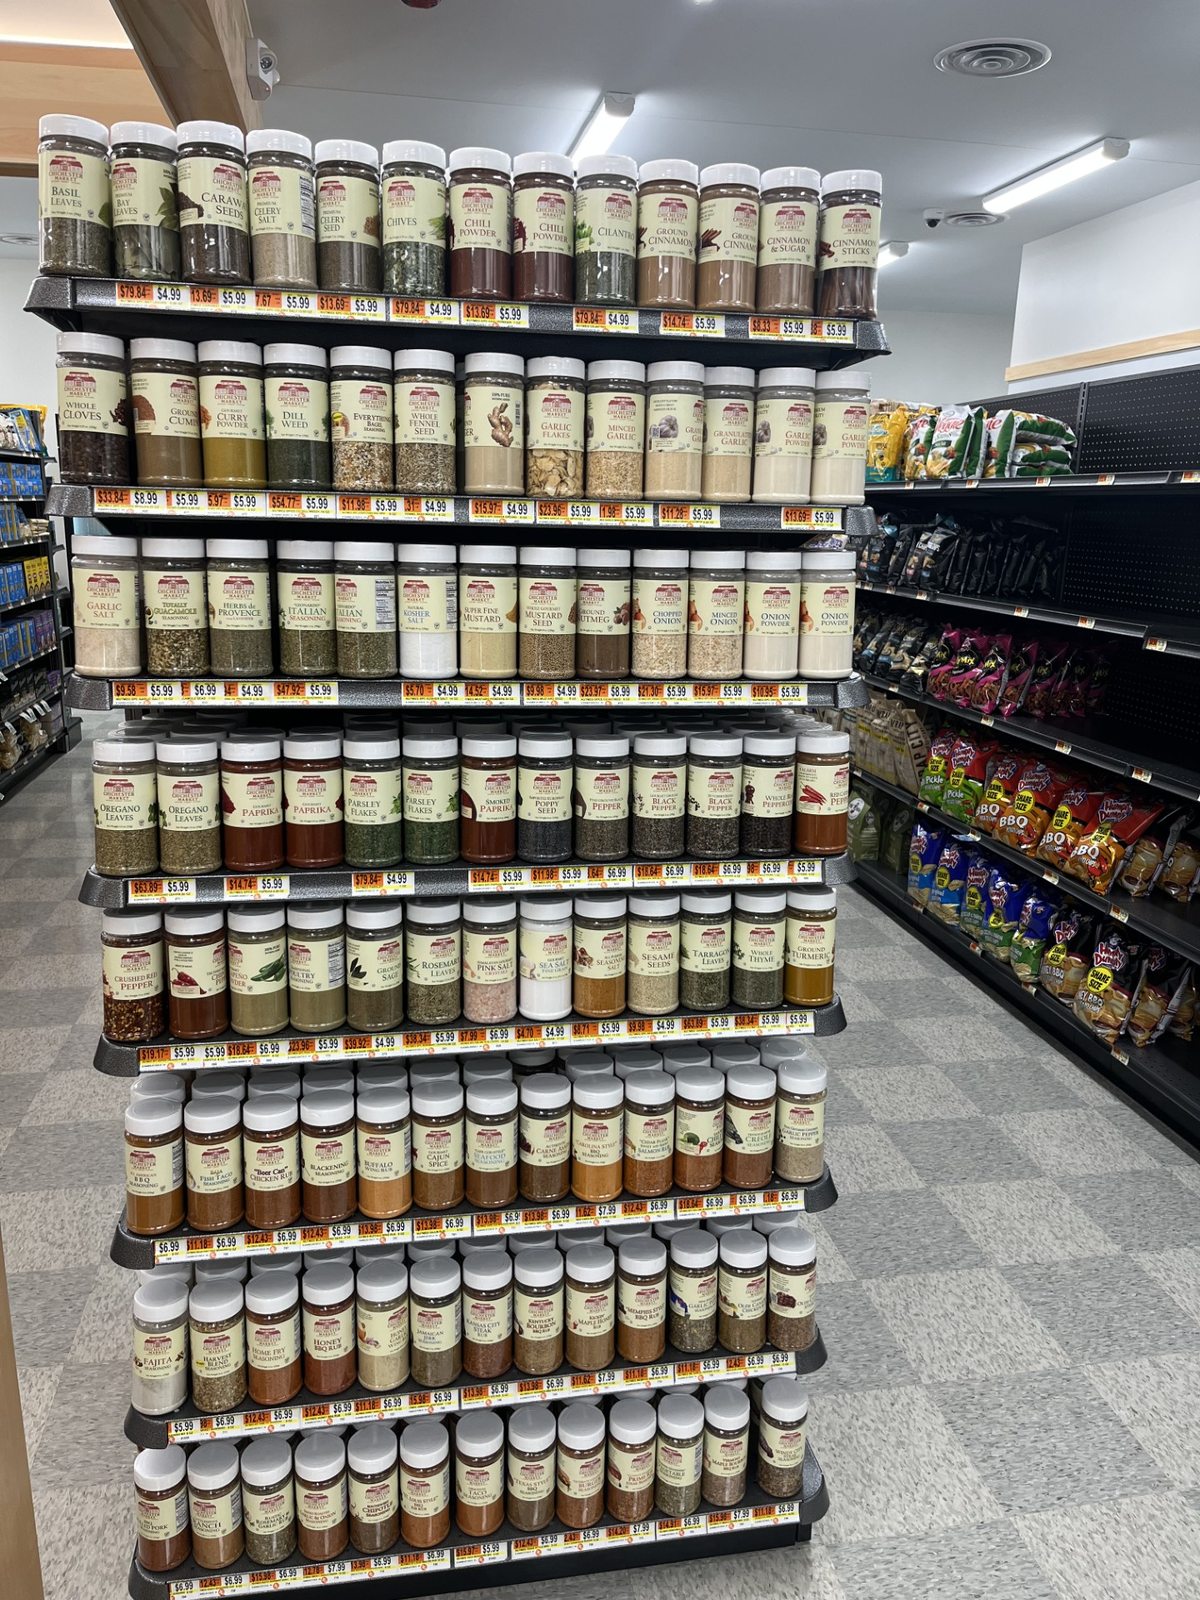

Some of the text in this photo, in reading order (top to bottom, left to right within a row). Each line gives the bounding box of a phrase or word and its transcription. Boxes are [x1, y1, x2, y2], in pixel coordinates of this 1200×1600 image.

[51, 186, 81, 198] BASIL
[51, 197, 82, 208] LEAVES
[259, 215, 276, 223] SALT
[387, 217, 417, 226] CHIVES
[465, 219, 491, 227] CHILI
[460, 228, 497, 237] POWDER
[539, 223, 565, 233] CHILI
[656, 228, 688, 236] GROUND
[780, 245, 806, 253] SUGAR
[842, 247, 870, 255] STICKS
[120, 286, 146, 297] $79.84
[158, 288, 181, 299] $4.99
[287, 296, 310, 308] $5.99
[430, 303, 452, 315] $4.99
[608, 314, 629, 325] $4.99
[783, 322, 803, 333] $5.99
[66, 402, 96, 410] WHOLE
[63, 410, 101, 420] CLOVES
[217, 413, 248, 421] CURRY
[283, 411, 306, 420] DILL
[216, 420, 248, 428] POWDER
[281, 420, 308, 429] WEED
[541, 423, 571, 431] GARLIC
[414, 427, 435, 435] SEED
[607, 432, 636, 440] GARLIC
[135, 493, 157, 504] $8.99
[234, 496, 256, 507] $5.99
[375, 501, 397, 511] $5.99
[507, 504, 528, 515] $4.99
[571, 506, 591, 516] $5.99
[692, 509, 712, 519] $5.99
[87, 602, 122, 610] GARLIC
[93, 610, 115, 618] SALT
[218, 609, 262, 617] PROVENCE
[525, 611, 562, 619] MUSTARD
[821, 612, 848, 620] ONION
[464, 614, 501, 623] MUSTARD
[116, 685, 136, 696] $9.58
[151, 685, 172, 696] $5.99
[241, 686, 263, 696] $4.99
[405, 685, 424, 695] $5.70
[437, 685, 458, 696] $4.99
[557, 685, 577, 696] $4.99
[667, 686, 686, 696] $5.99
[781, 687, 800, 697] $5.99
[925, 776, 944, 784] Pickle
[1015, 792, 1033, 803] SHARE
[100, 804, 140, 813] OREGANO
[535, 800, 560, 808] POPPY
[592, 802, 622, 810] PEPPER
[1015, 801, 1028, 812] SIZE
[168, 805, 209, 814] OREGANO
[294, 806, 331, 814] PAPRIKA
[105, 813, 134, 821] LEAVES
[175, 814, 203, 822] LEAVES
[1000, 815, 1028, 829] BBQ
[723, 864, 741, 874] $6.99
[797, 862, 815, 872] $5.99
[503, 871, 522, 881] $5.99
[608, 868, 626, 877] $6.99
[262, 878, 283, 888] $5.99
[642, 953, 675, 961] SESAME
[498, 962, 513, 970] SALT
[647, 960, 671, 968] SEEDS
[115, 974, 144, 982] CRUSHED
[1090, 970, 1110, 983] SHARE
[120, 981, 153, 990] PEPPER
[1088, 980, 1102, 990] SIZE
[710, 1017, 728, 1027] $5.99
[790, 1013, 807, 1023] $5.99
[602, 1022, 620, 1032] $5.99
[489, 1030, 508, 1039] $6.99
[318, 1039, 339, 1049] $5.99
[375, 1037, 394, 1047] $4.99
[205, 1047, 225, 1057] $5.99
[310, 1162, 348, 1171] BLACKENING
[250, 1174, 277, 1182] CHICKEN
[781, 1191, 798, 1201] $6.99
[705, 1197, 723, 1207] $6.99
[599, 1205, 616, 1215] $7.99
[445, 1218, 464, 1229] $6.99
[332, 1226, 351, 1236] $6.99
[216, 1237, 236, 1248] $6.99
[314, 1338, 342, 1346] HONEY
[204, 1353, 232, 1361] HARVEST
[748, 1356, 764, 1366] $6.99
[772, 1353, 789, 1364] $6.99
[651, 1367, 668, 1377] $6.99
[546, 1379, 564, 1389] $6.99
[434, 1393, 452, 1402] $6.99
[333, 1404, 352, 1414] $6.99
[215, 1417, 234, 1427] $6.99
[778, 1504, 794, 1514] $6.99
[683, 1518, 700, 1528] $6.99
[583, 1530, 600, 1540] $6.99
[541, 1536, 557, 1546] $6.99
[427, 1550, 445, 1561] $6.99
[327, 1563, 345, 1573] $7.99
[224, 1576, 243, 1586] $6.99
